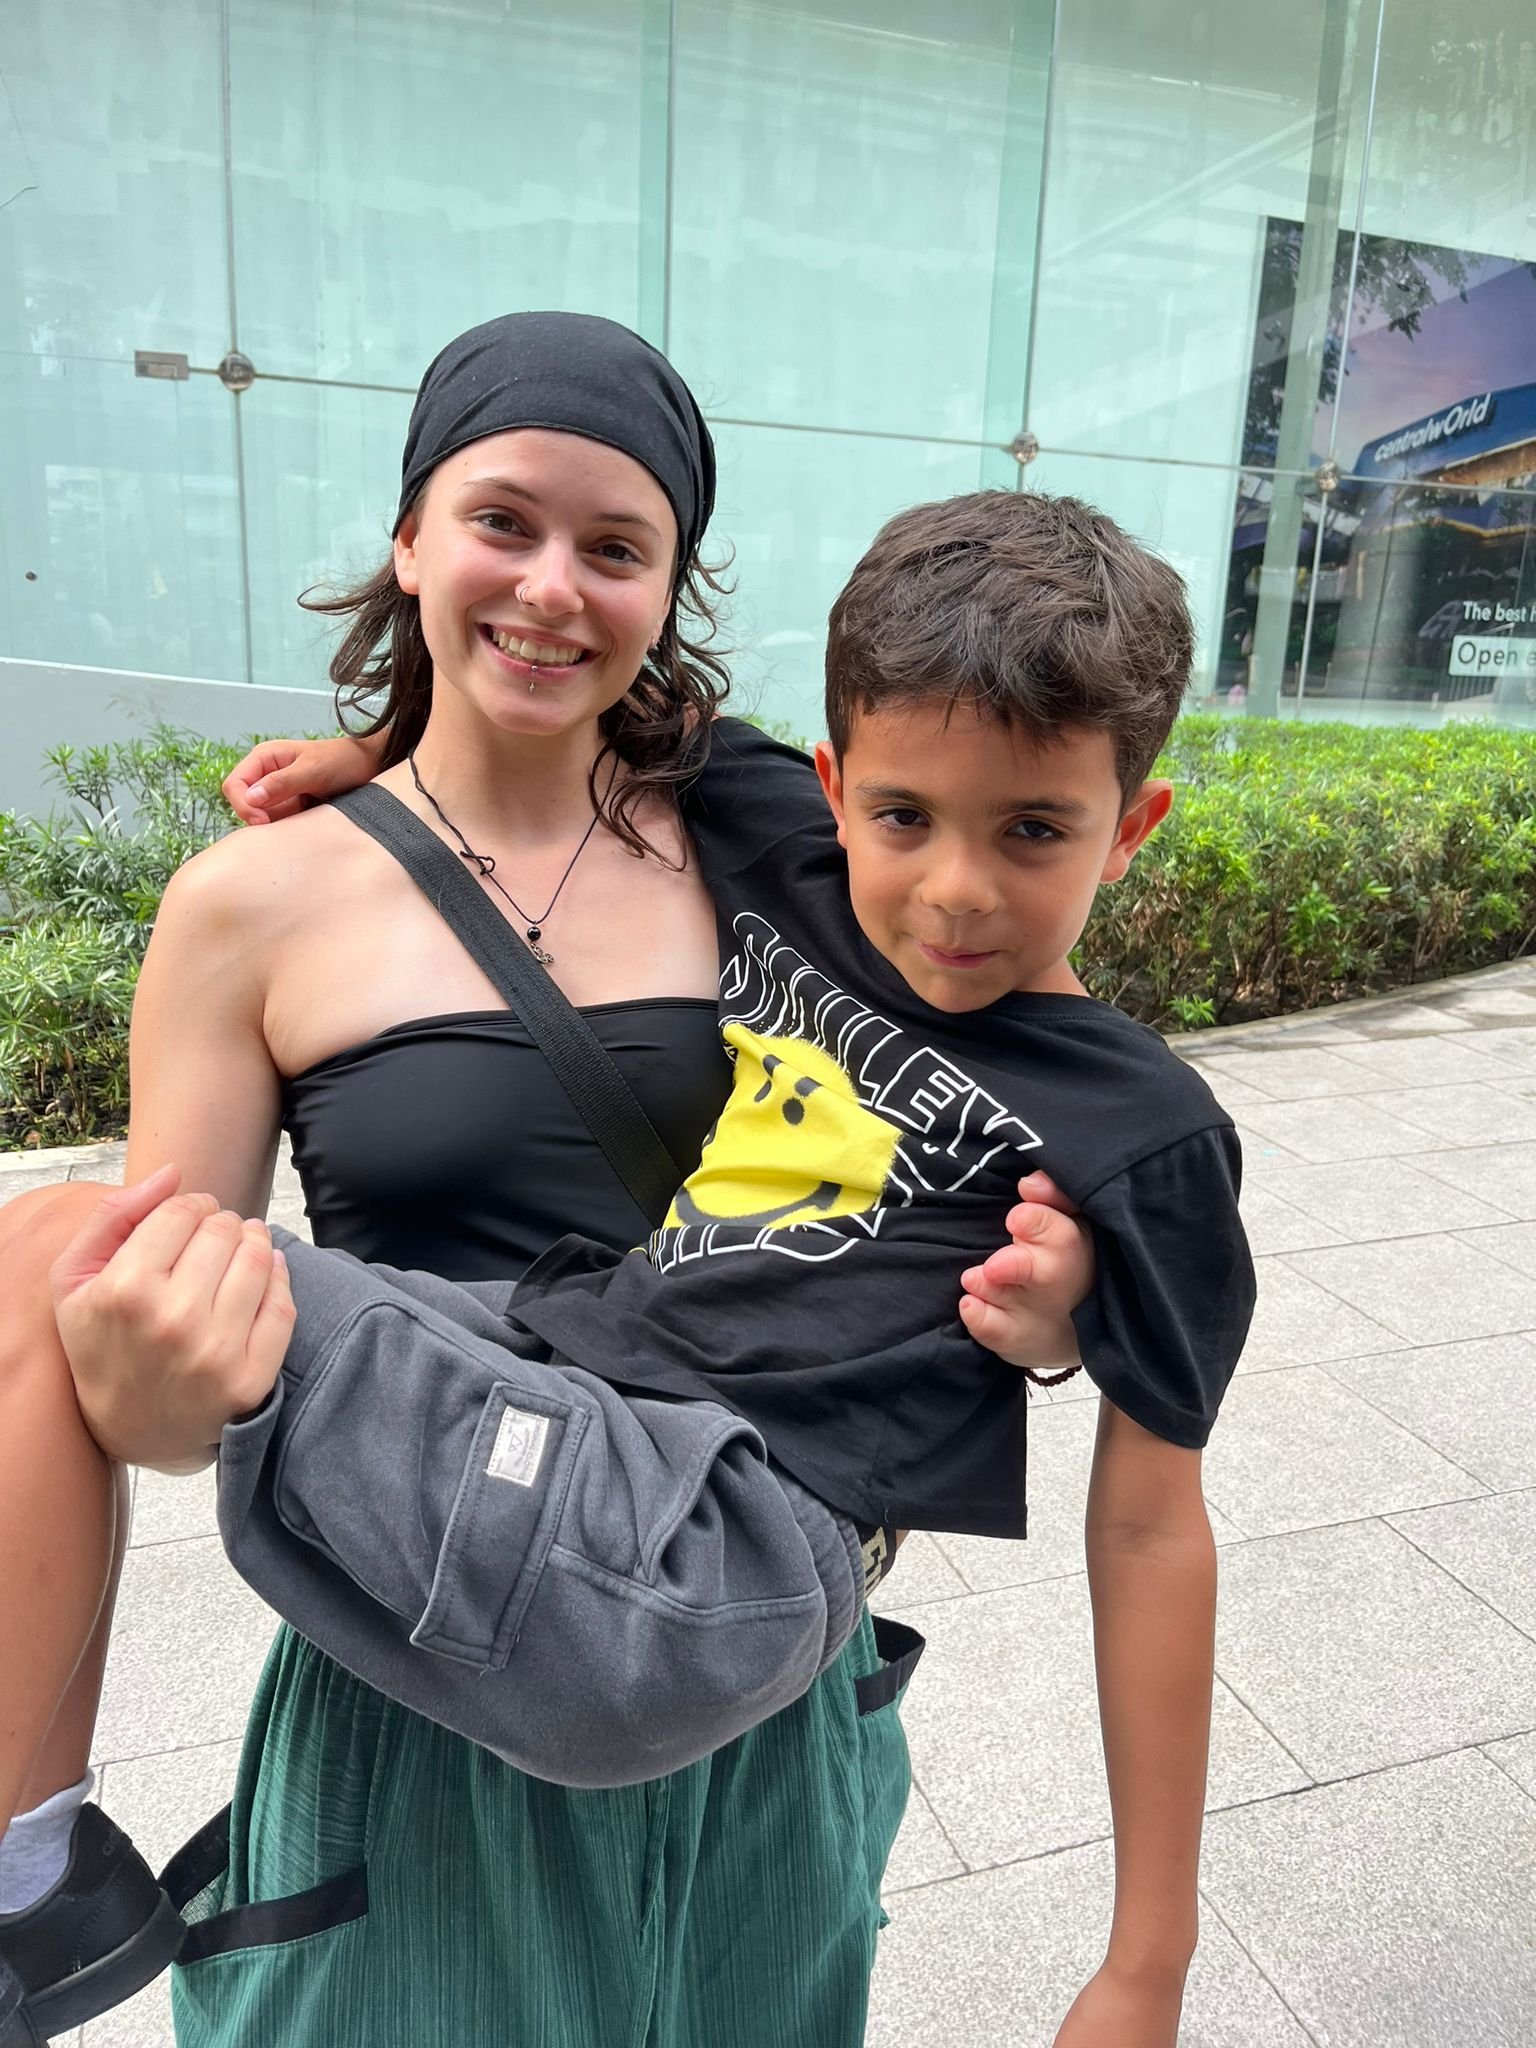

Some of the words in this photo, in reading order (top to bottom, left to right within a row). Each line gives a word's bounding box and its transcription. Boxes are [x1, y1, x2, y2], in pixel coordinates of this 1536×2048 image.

[1463, 600, 1491, 621] The
[1495, 602, 1525, 622] best
[1458, 641, 1518, 672] Open
